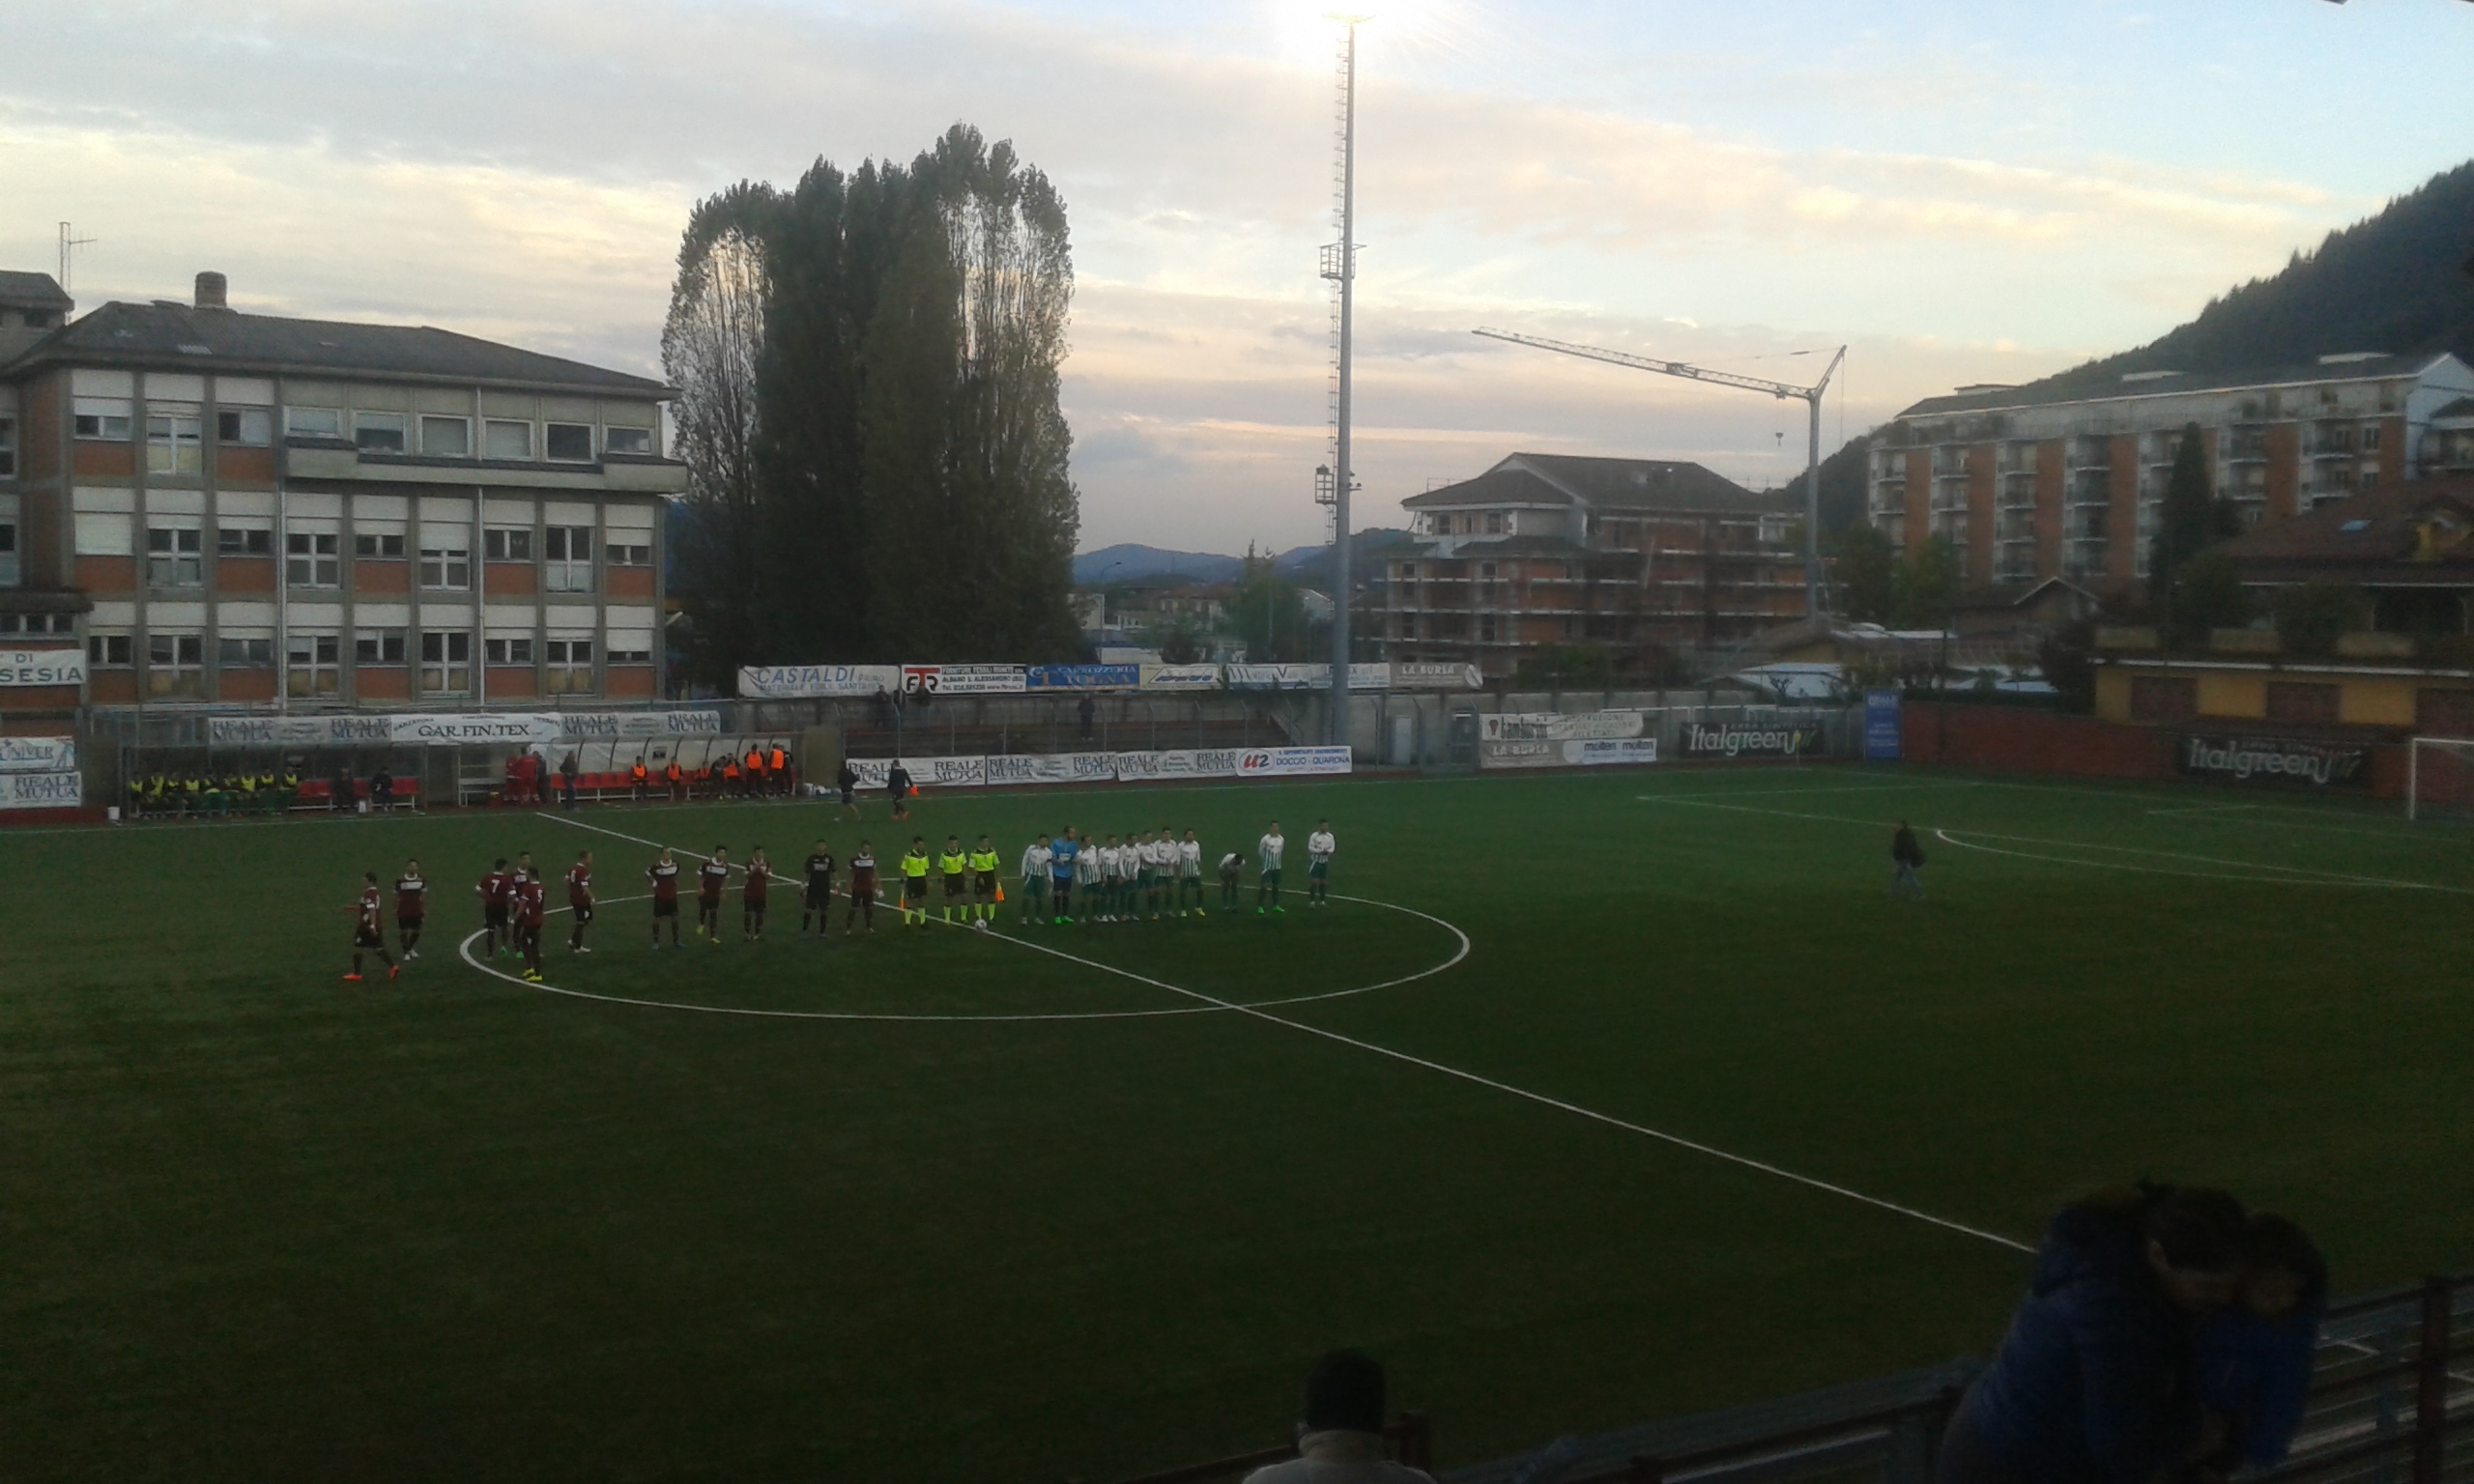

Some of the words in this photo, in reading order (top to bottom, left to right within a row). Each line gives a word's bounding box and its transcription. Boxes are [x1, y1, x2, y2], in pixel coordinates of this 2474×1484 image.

[15, 653, 33, 664] DI
[759, 667, 856, 683] CASTALDI
[1057, 666, 1136, 674] CARROZZERIA
[1402, 665, 1416, 674] LA
[214, 720, 274, 730] REALE
[331, 718, 390, 729] REALE
[564, 715, 618, 725] REALE
[1689, 724, 1796, 756] Italgreen
[1074, 755, 1115, 765] REALE
[1118, 755, 1159, 766] REALE
[1196, 753, 1237, 762] REALE
[2190, 738, 2332, 784] Italgreen
[848, 761, 890, 774] REAL
[935, 760, 985, 773] REALE
[989, 758, 1033, 770] REALE
[1196, 760, 1236, 772] MUTUA
[935, 770, 984, 783] MUTUA
[989, 768, 1033, 778] MUTUA
[15, 775, 79, 787] REALE
[14, 786, 78, 800] MUTUA
[491, 879, 501, 894] 7
